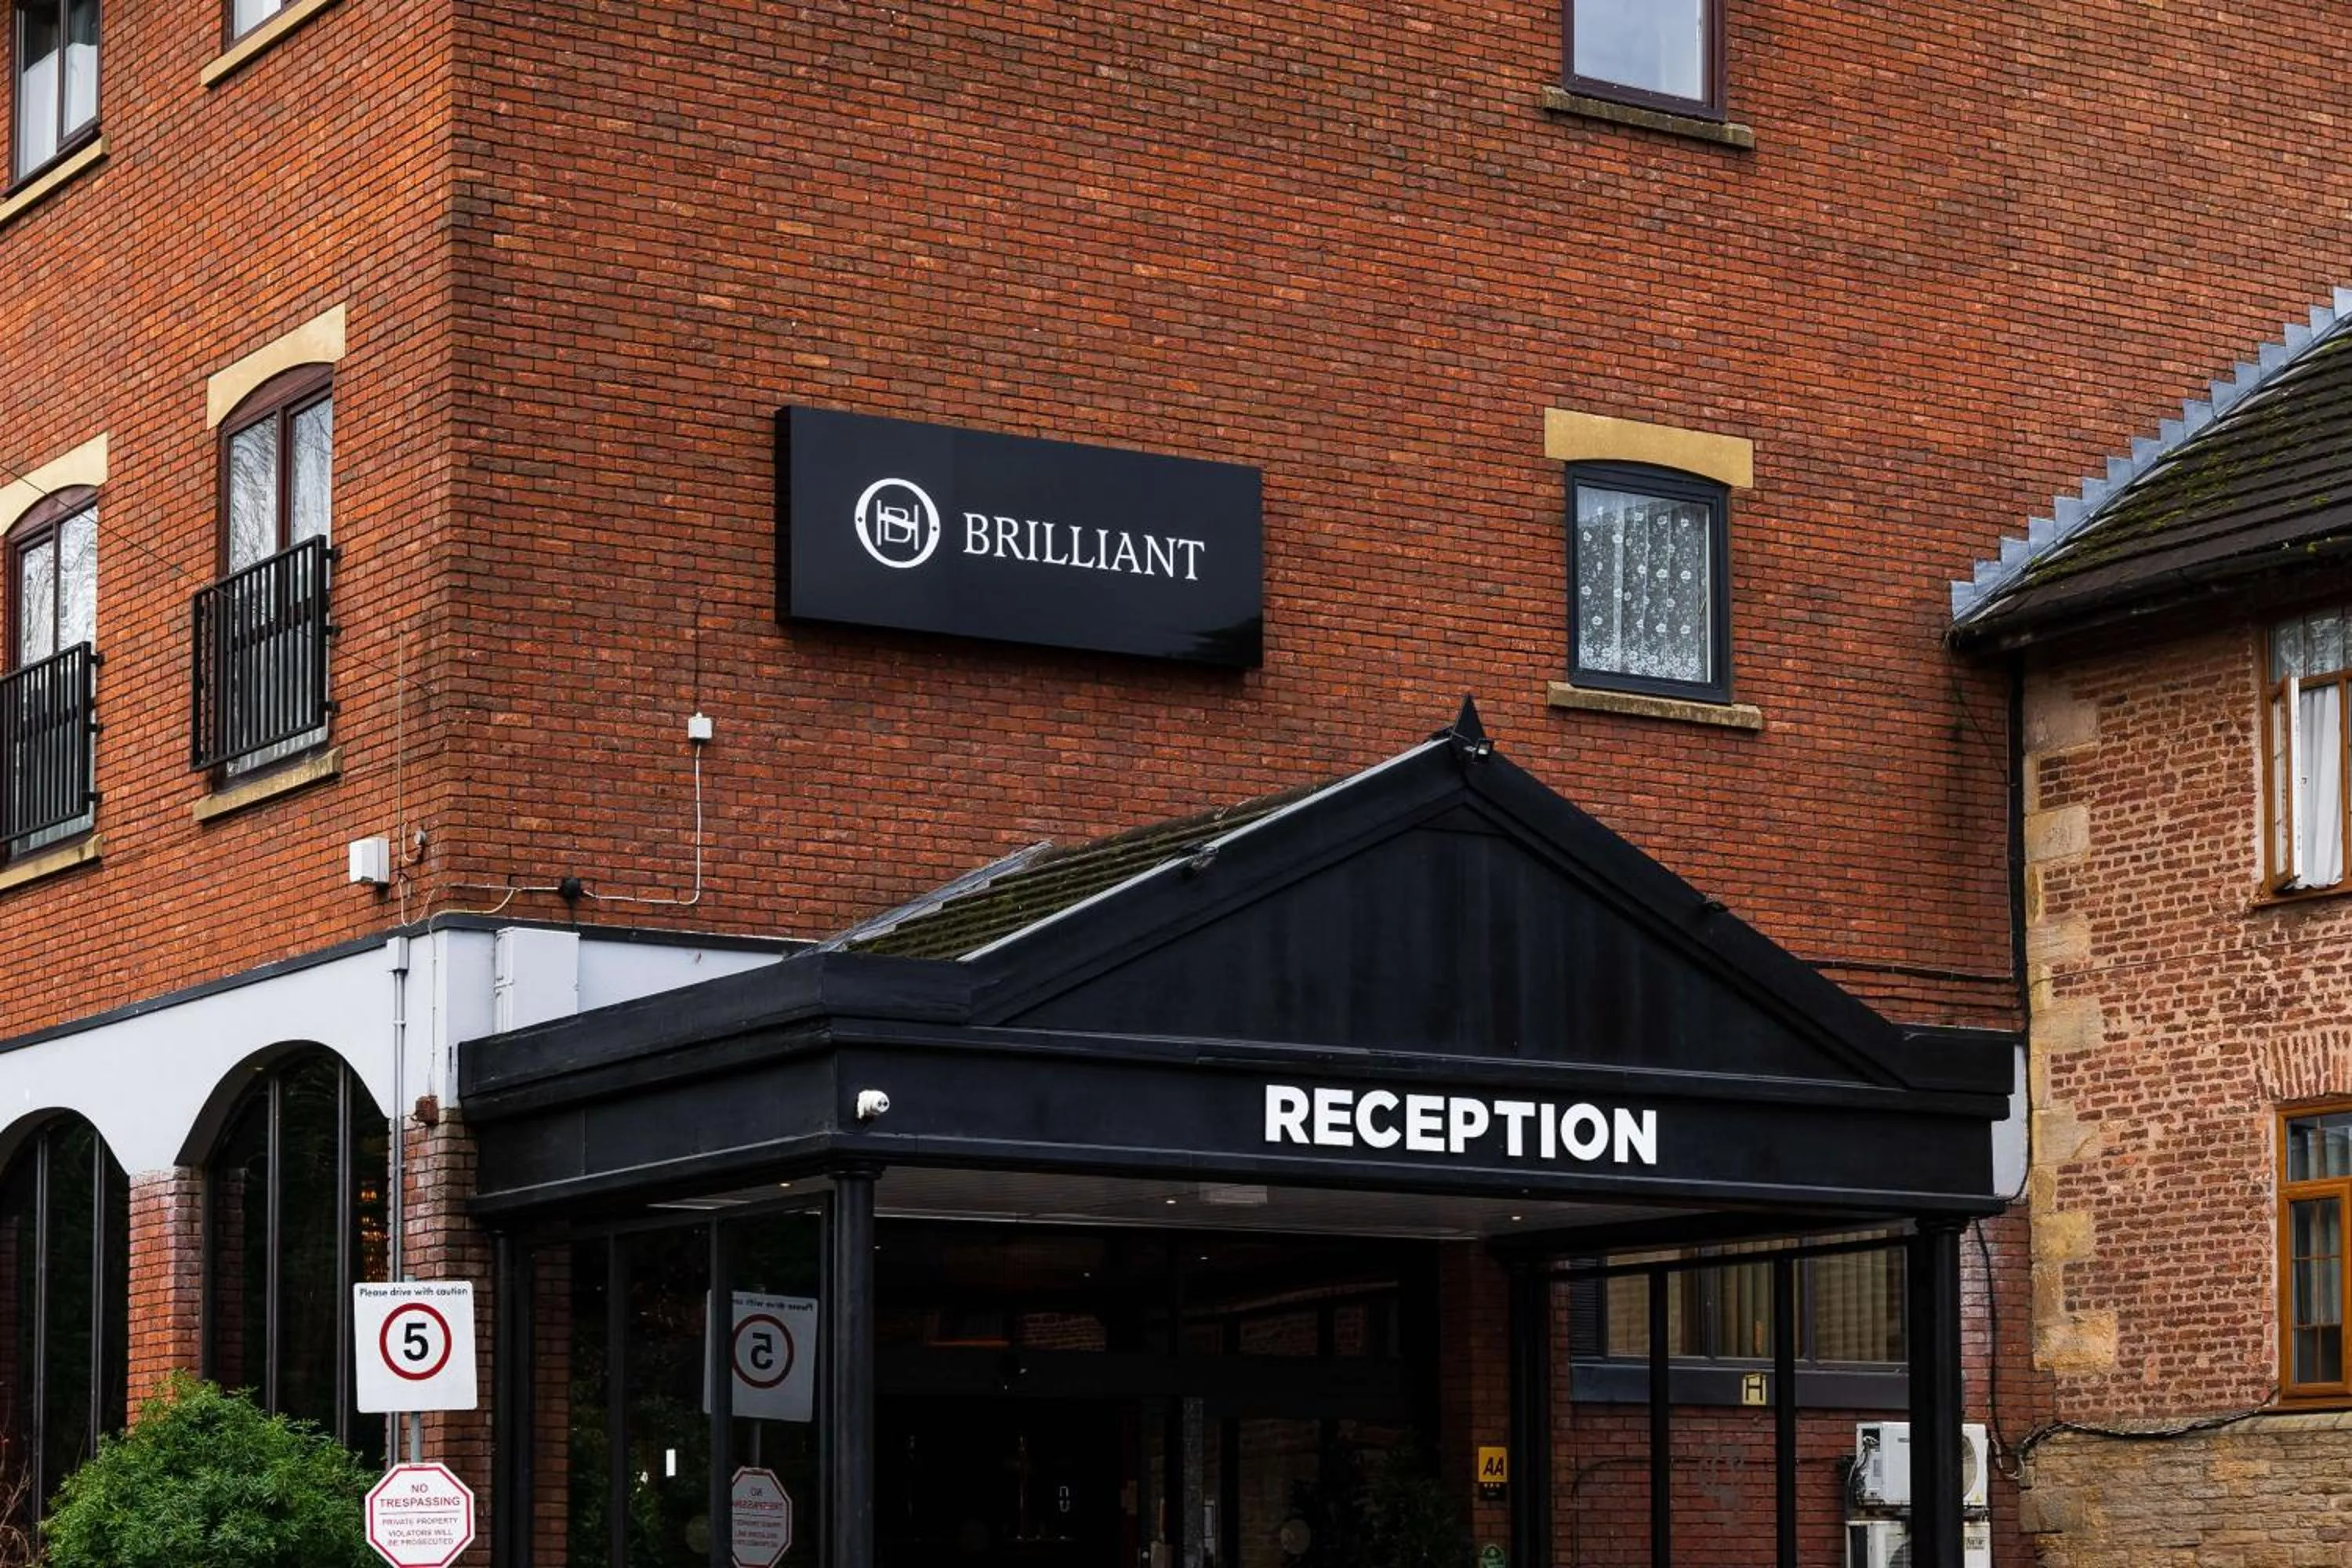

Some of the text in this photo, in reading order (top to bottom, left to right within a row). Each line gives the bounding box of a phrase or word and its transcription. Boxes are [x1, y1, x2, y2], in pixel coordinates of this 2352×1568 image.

[963, 512, 1205, 580] BRILLIANT
[1265, 1084, 1657, 1165] RECEPTION
[359, 1286, 468, 1297] Please drive with caution
[403, 1323, 429, 1362] 5
[1746, 1376, 1763, 1401] H
[1483, 1456, 1504, 1476] AA
[411, 1483, 429, 1493] NO
[379, 1497, 461, 1508] TRESPASSING
